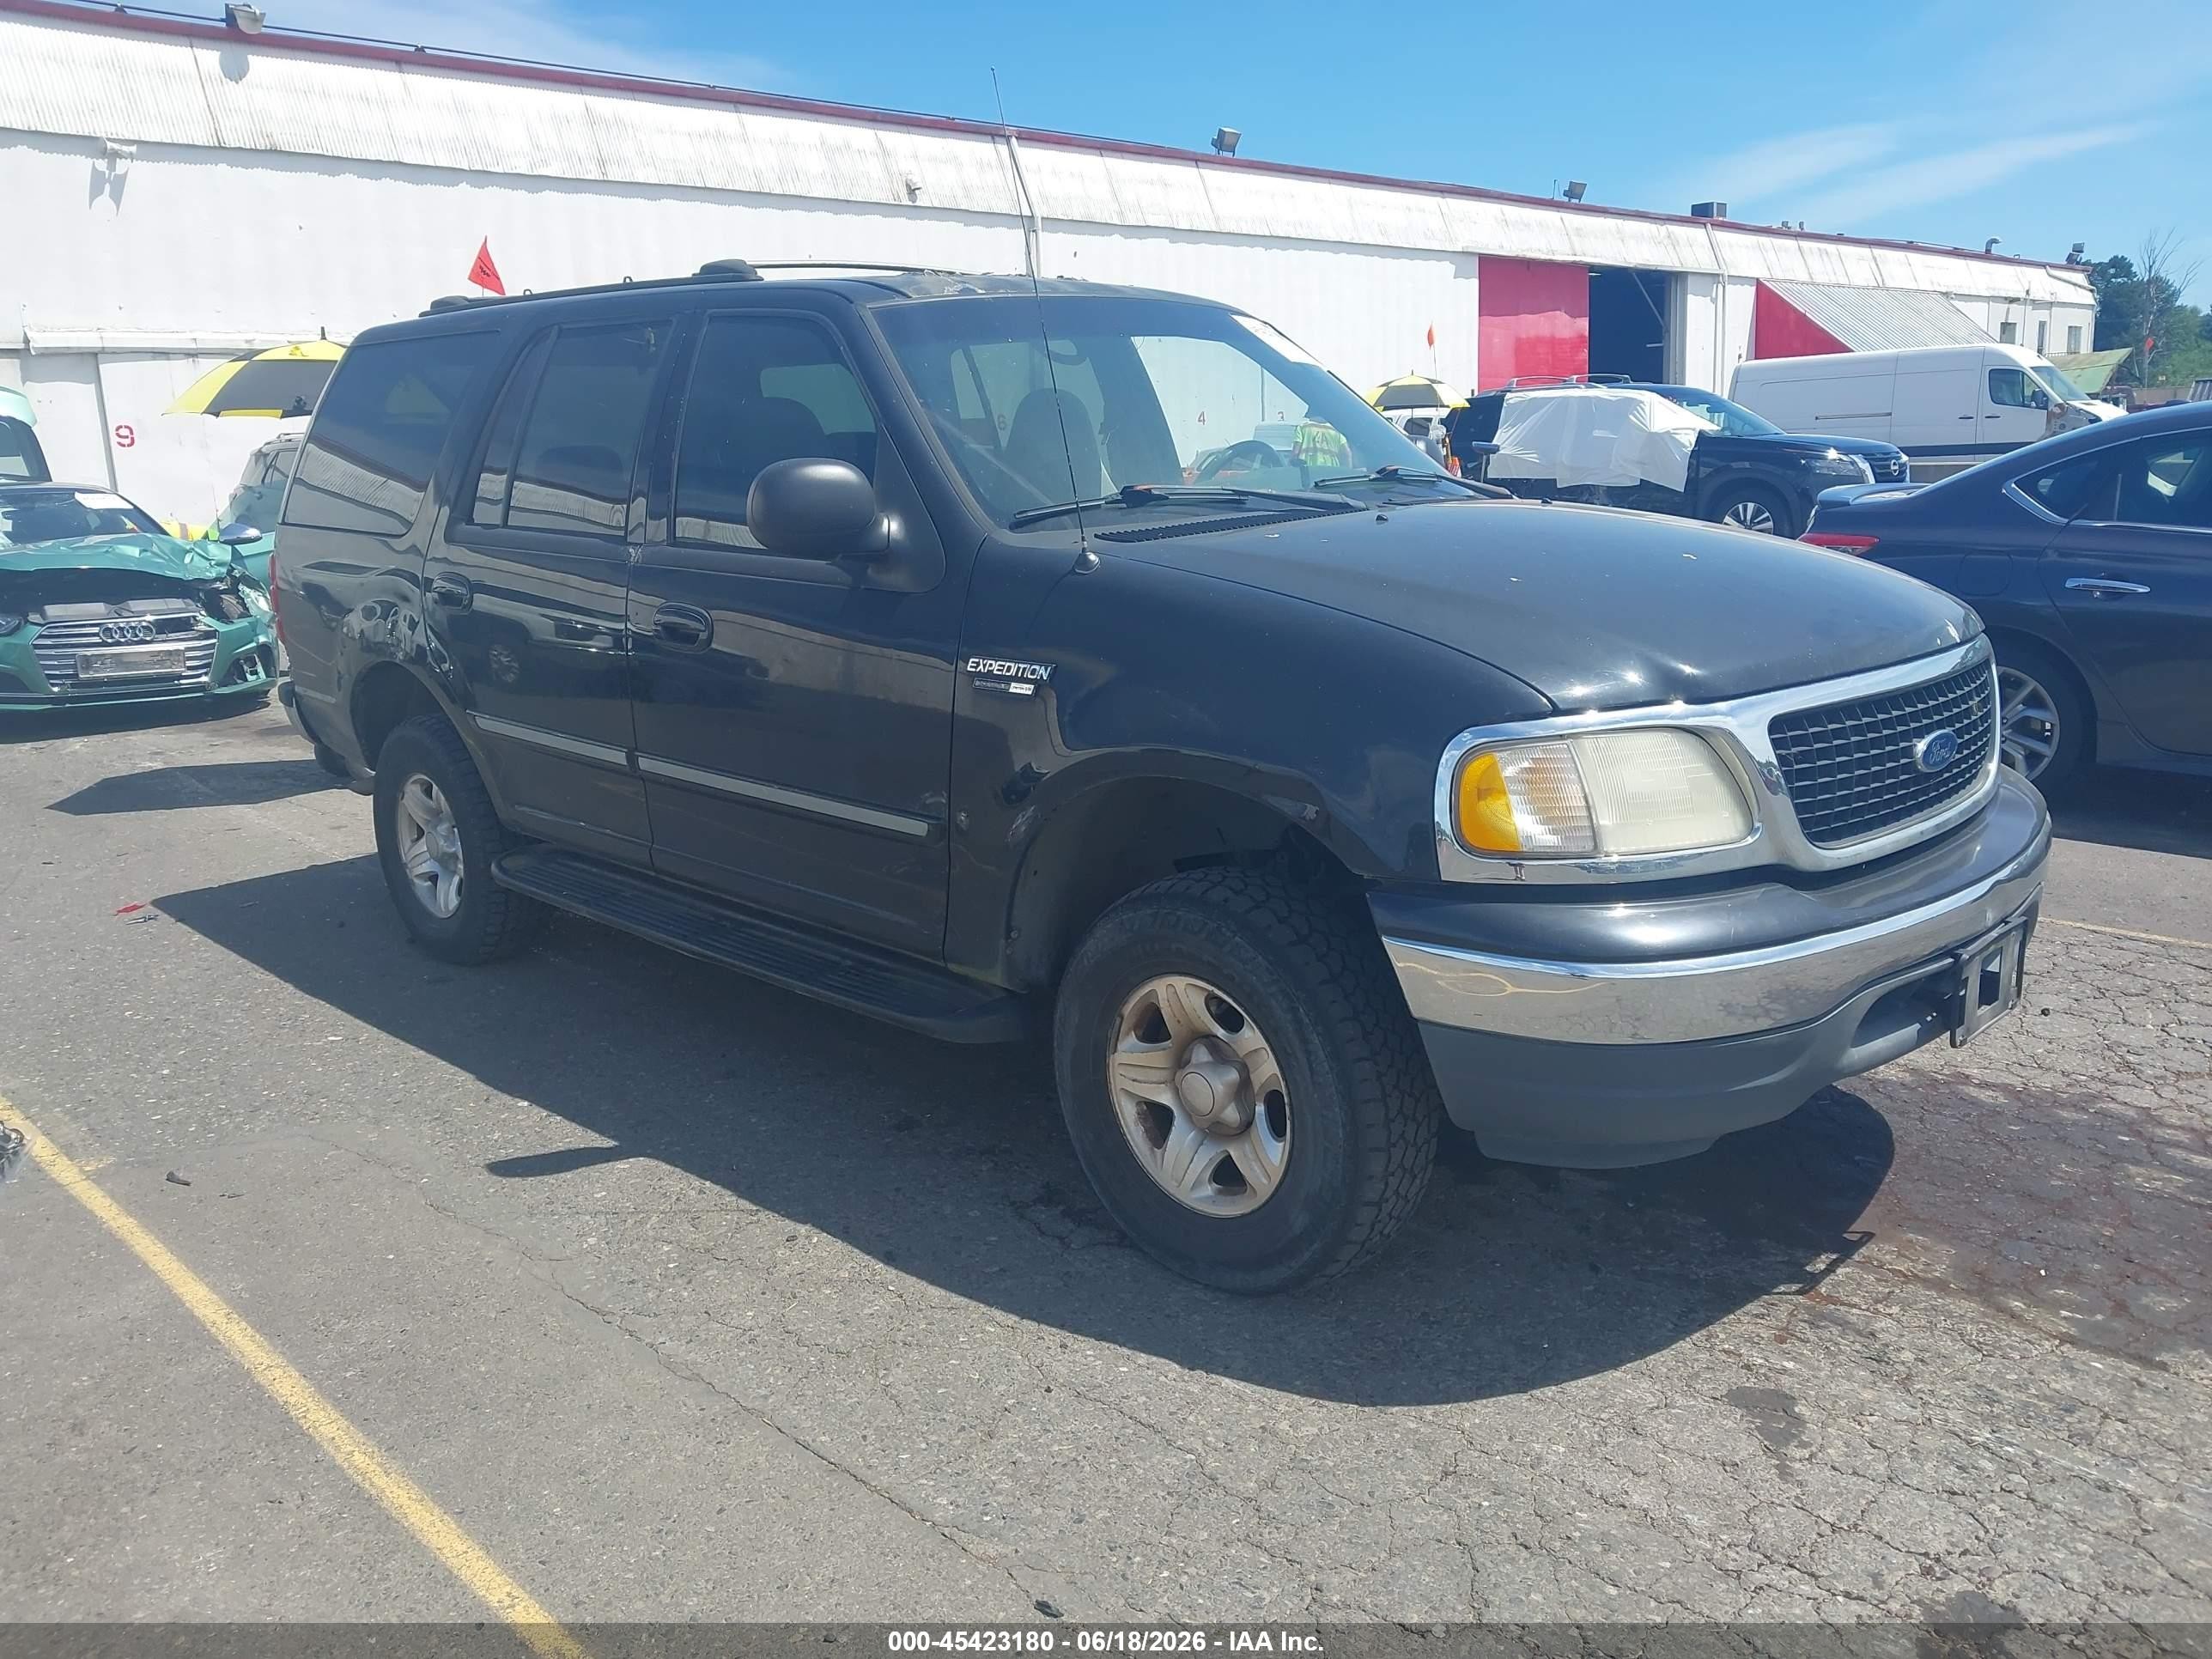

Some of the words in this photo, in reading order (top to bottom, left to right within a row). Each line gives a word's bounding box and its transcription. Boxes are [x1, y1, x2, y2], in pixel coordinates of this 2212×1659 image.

[1198, 410, 1206, 426] 4
[114, 424, 136, 447] 9
[967, 658, 1051, 680] EXPEDITION
[1929, 738, 1953, 764] Ford
